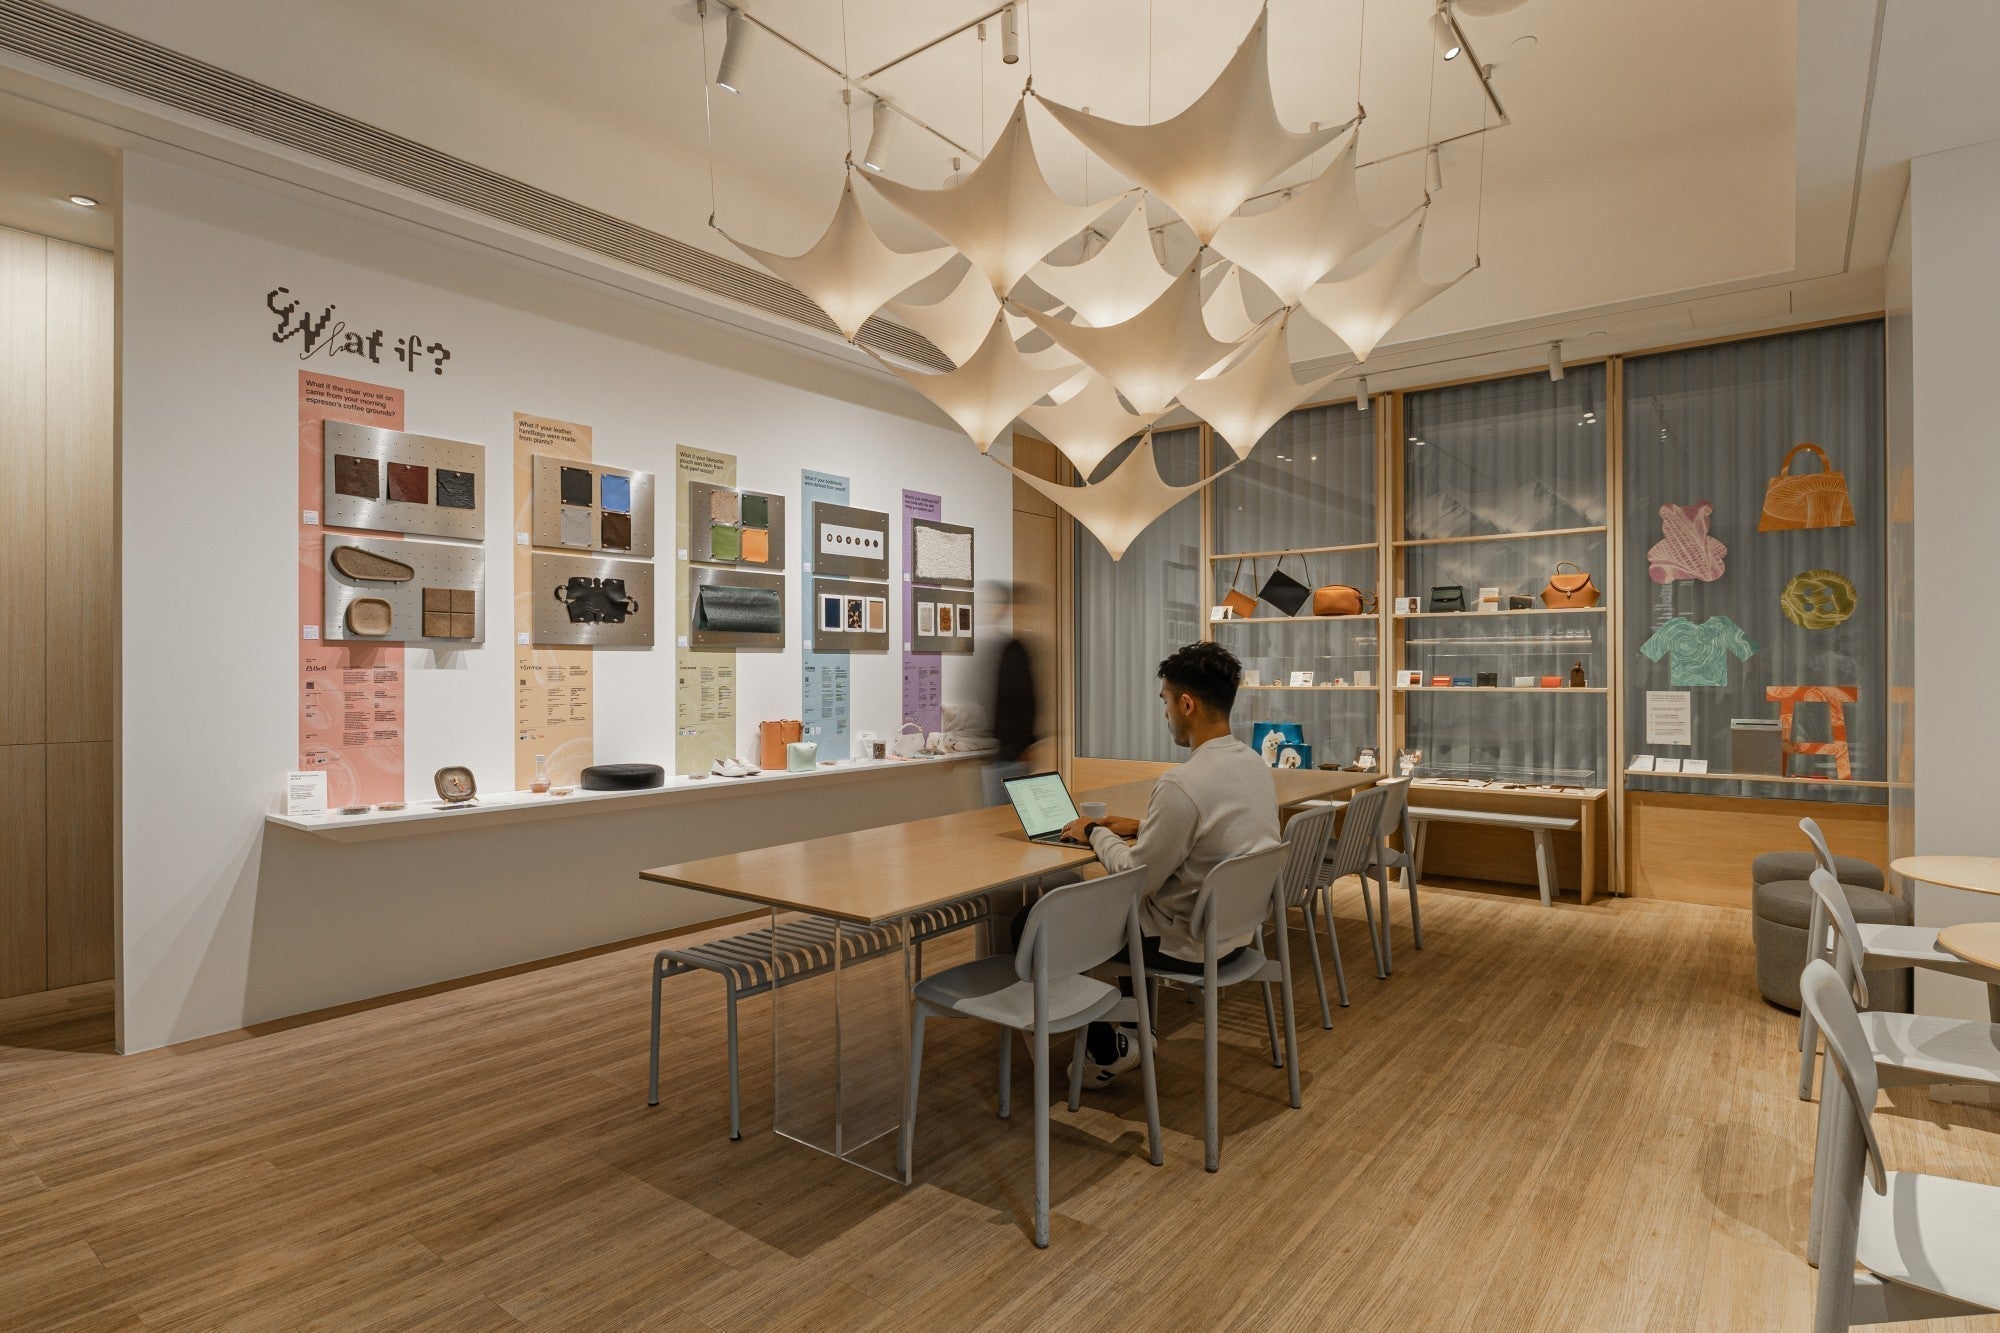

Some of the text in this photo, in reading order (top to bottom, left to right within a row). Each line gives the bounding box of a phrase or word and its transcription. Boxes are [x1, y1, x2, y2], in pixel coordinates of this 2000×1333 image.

[305, 379, 324, 389] What
[345, 387, 361, 395] chair
[376, 392, 384, 400] sit
[305, 389, 387, 409] came from your morning
[305, 396, 396, 417] espresso's coffee grounds?
[518, 421, 534, 429] What
[553, 427, 572, 435] leather
[518, 428, 546, 438] handbags
